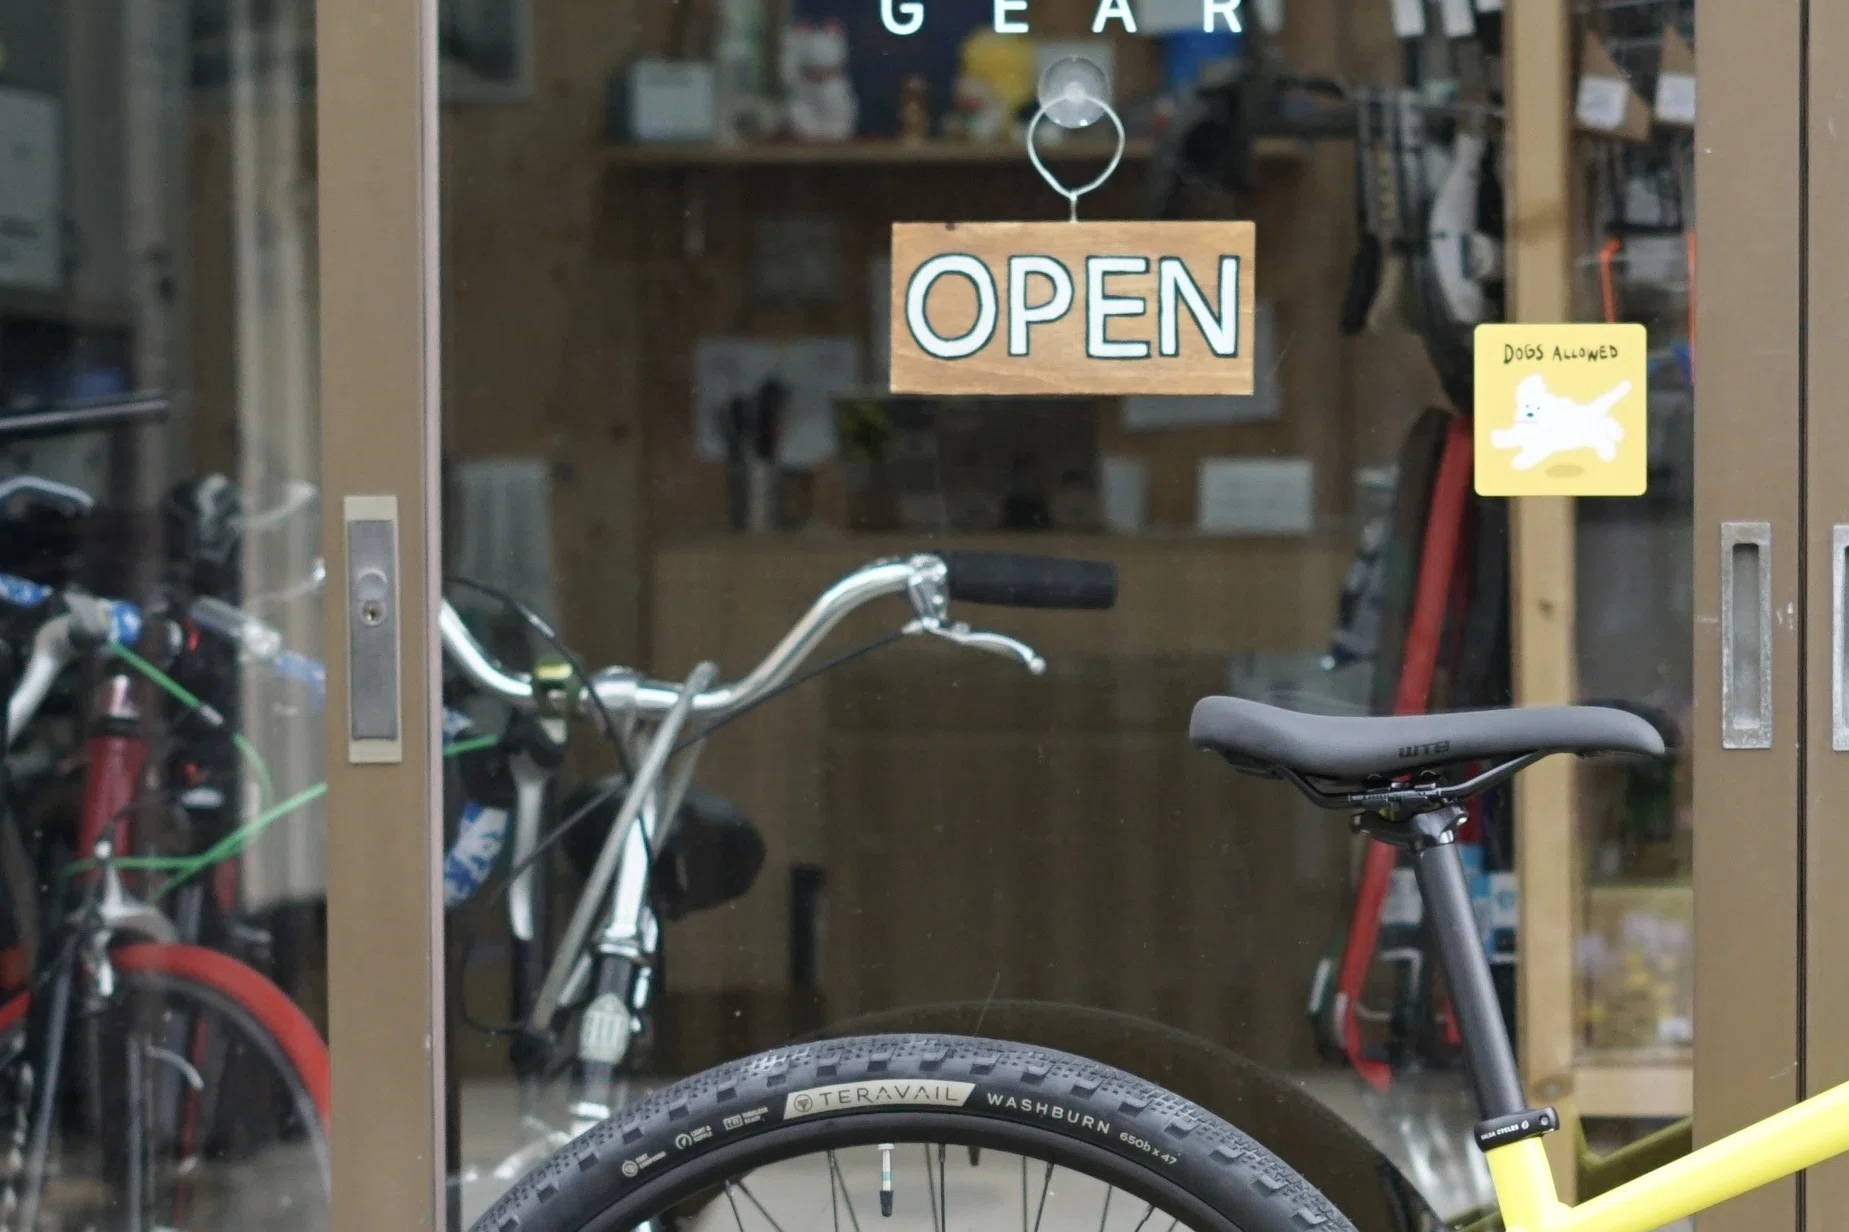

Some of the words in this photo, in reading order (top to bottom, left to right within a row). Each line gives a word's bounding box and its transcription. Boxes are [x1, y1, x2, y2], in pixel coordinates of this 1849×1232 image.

[881, 0, 1243, 35] GEAR
[905, 253, 1240, 360] OPEN
[1503, 343, 1544, 364] DOGS
[1552, 345, 1619, 362] ALLOWED
[819, 1085, 959, 1107] TERAVAIL
[987, 1092, 1110, 1134] WASHBURN
[1119, 1132, 1151, 1152] 650b
[1161, 1153, 1178, 1165] 47
